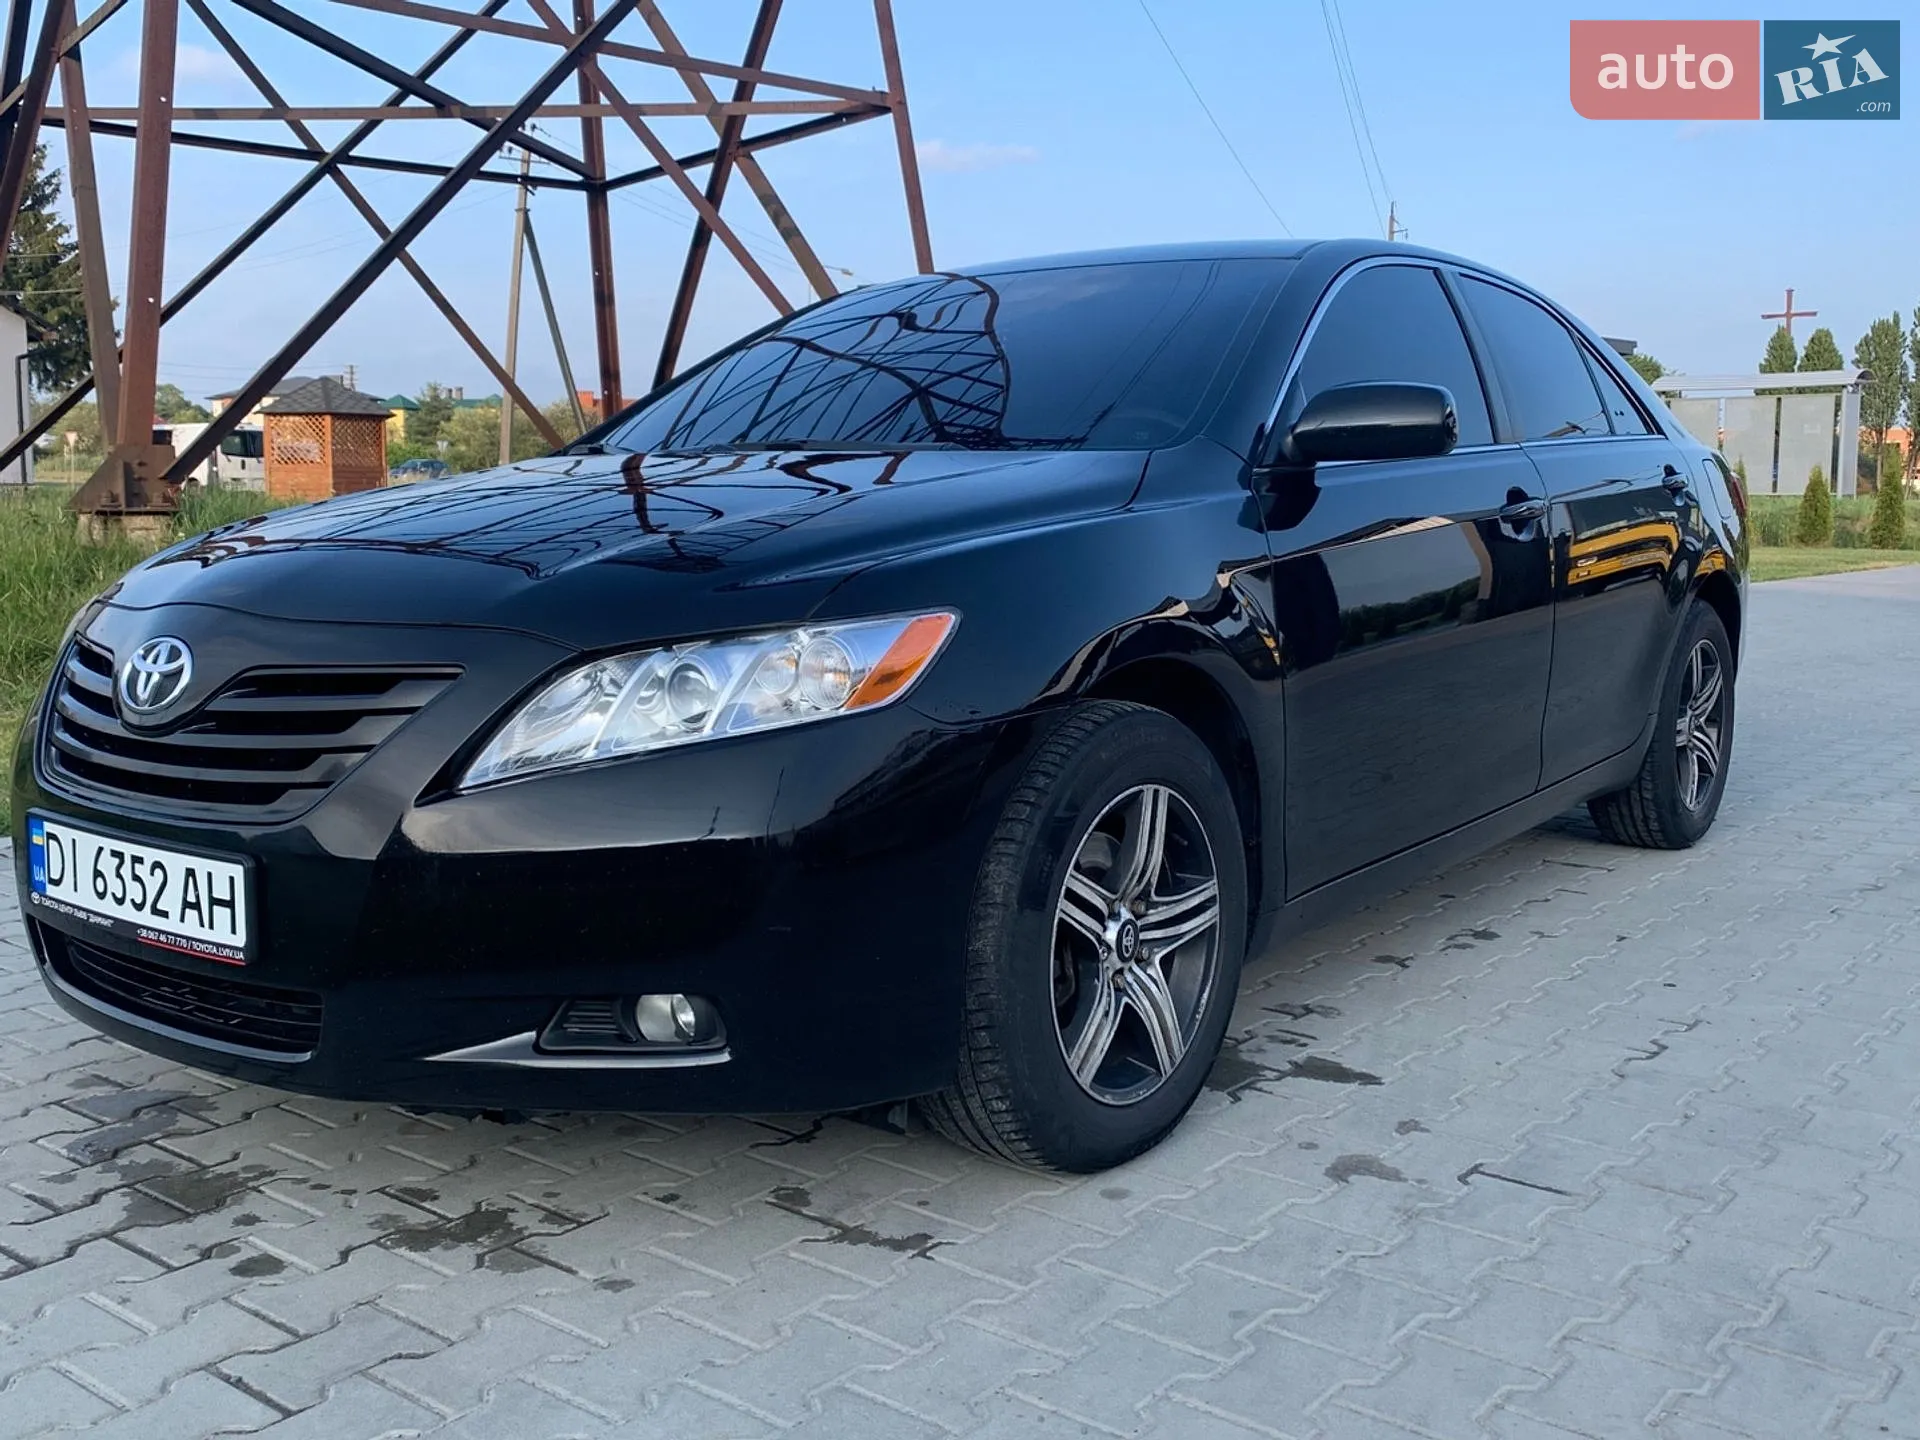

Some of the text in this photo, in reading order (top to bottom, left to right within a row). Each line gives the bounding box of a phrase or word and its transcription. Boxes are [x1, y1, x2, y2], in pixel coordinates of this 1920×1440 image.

[33, 863, 46, 883] UA
[46, 831, 237, 936] DI 6352 AH
